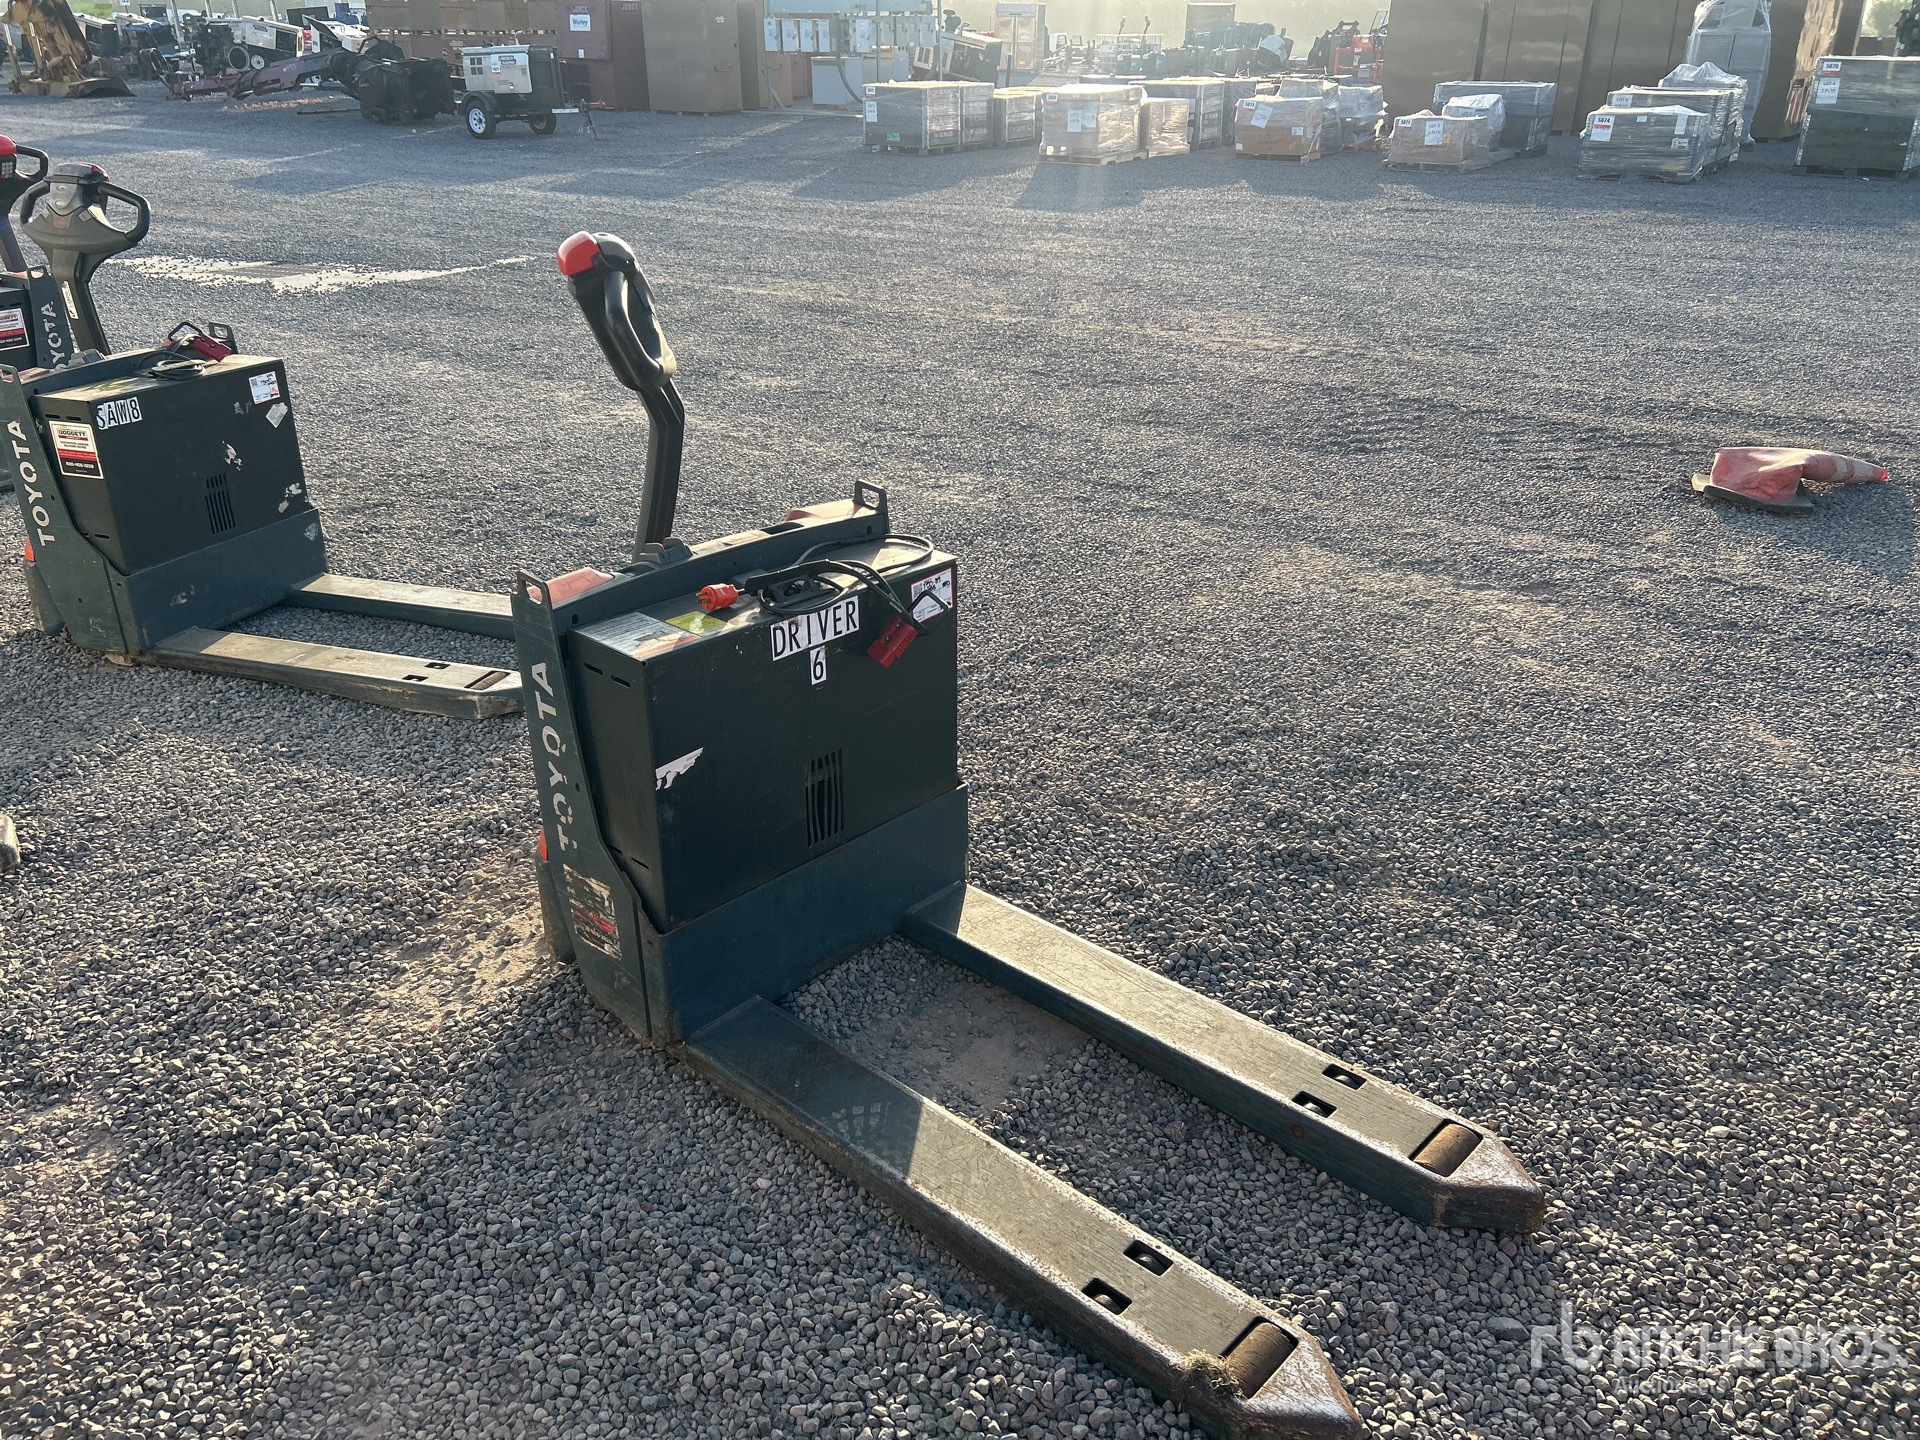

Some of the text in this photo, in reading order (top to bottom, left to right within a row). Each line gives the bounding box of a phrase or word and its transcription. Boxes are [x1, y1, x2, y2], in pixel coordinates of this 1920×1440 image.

[41, 301, 67, 369] YOTA
[7, 420, 56, 547] TOYOTA
[772, 600, 858, 658] DRIVER
[813, 649, 824, 681] 6
[531, 661, 578, 852] TOYOTA
